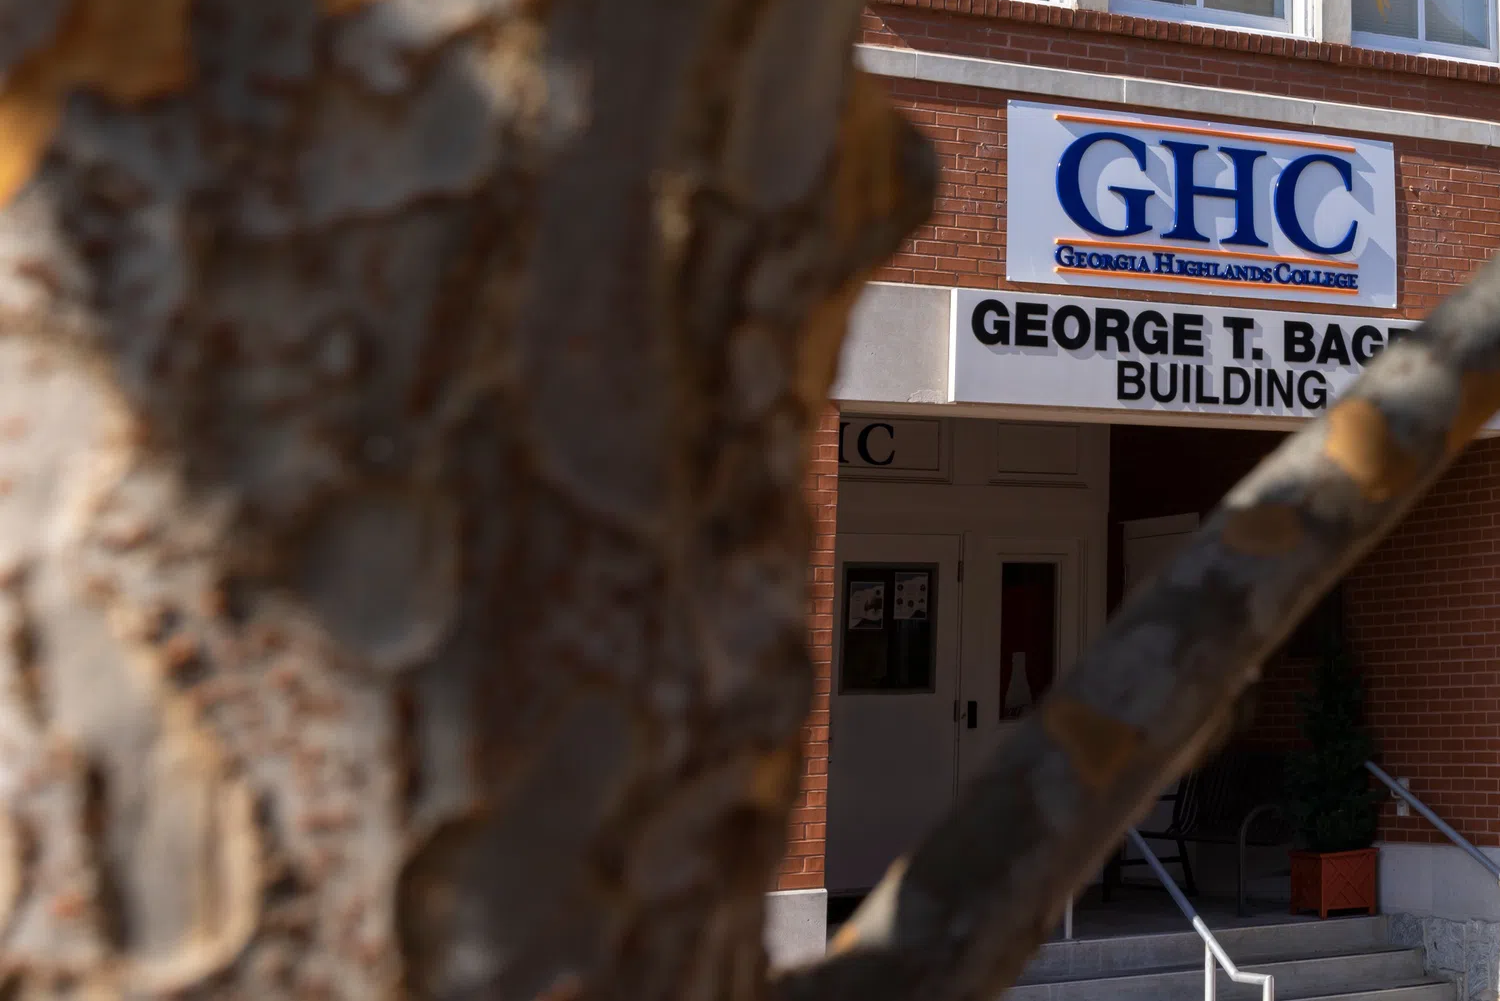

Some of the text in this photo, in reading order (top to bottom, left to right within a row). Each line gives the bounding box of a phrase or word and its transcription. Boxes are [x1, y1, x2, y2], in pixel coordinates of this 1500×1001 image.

[1055, 131, 1359, 255] GHC
[1054, 244, 1360, 290] GEORGIA HIGHLANDS COLLEGE
[971, 298, 1204, 356] GEORGE
[1223, 316, 1264, 361] T.
[1116, 360, 1328, 410] BUILDING
